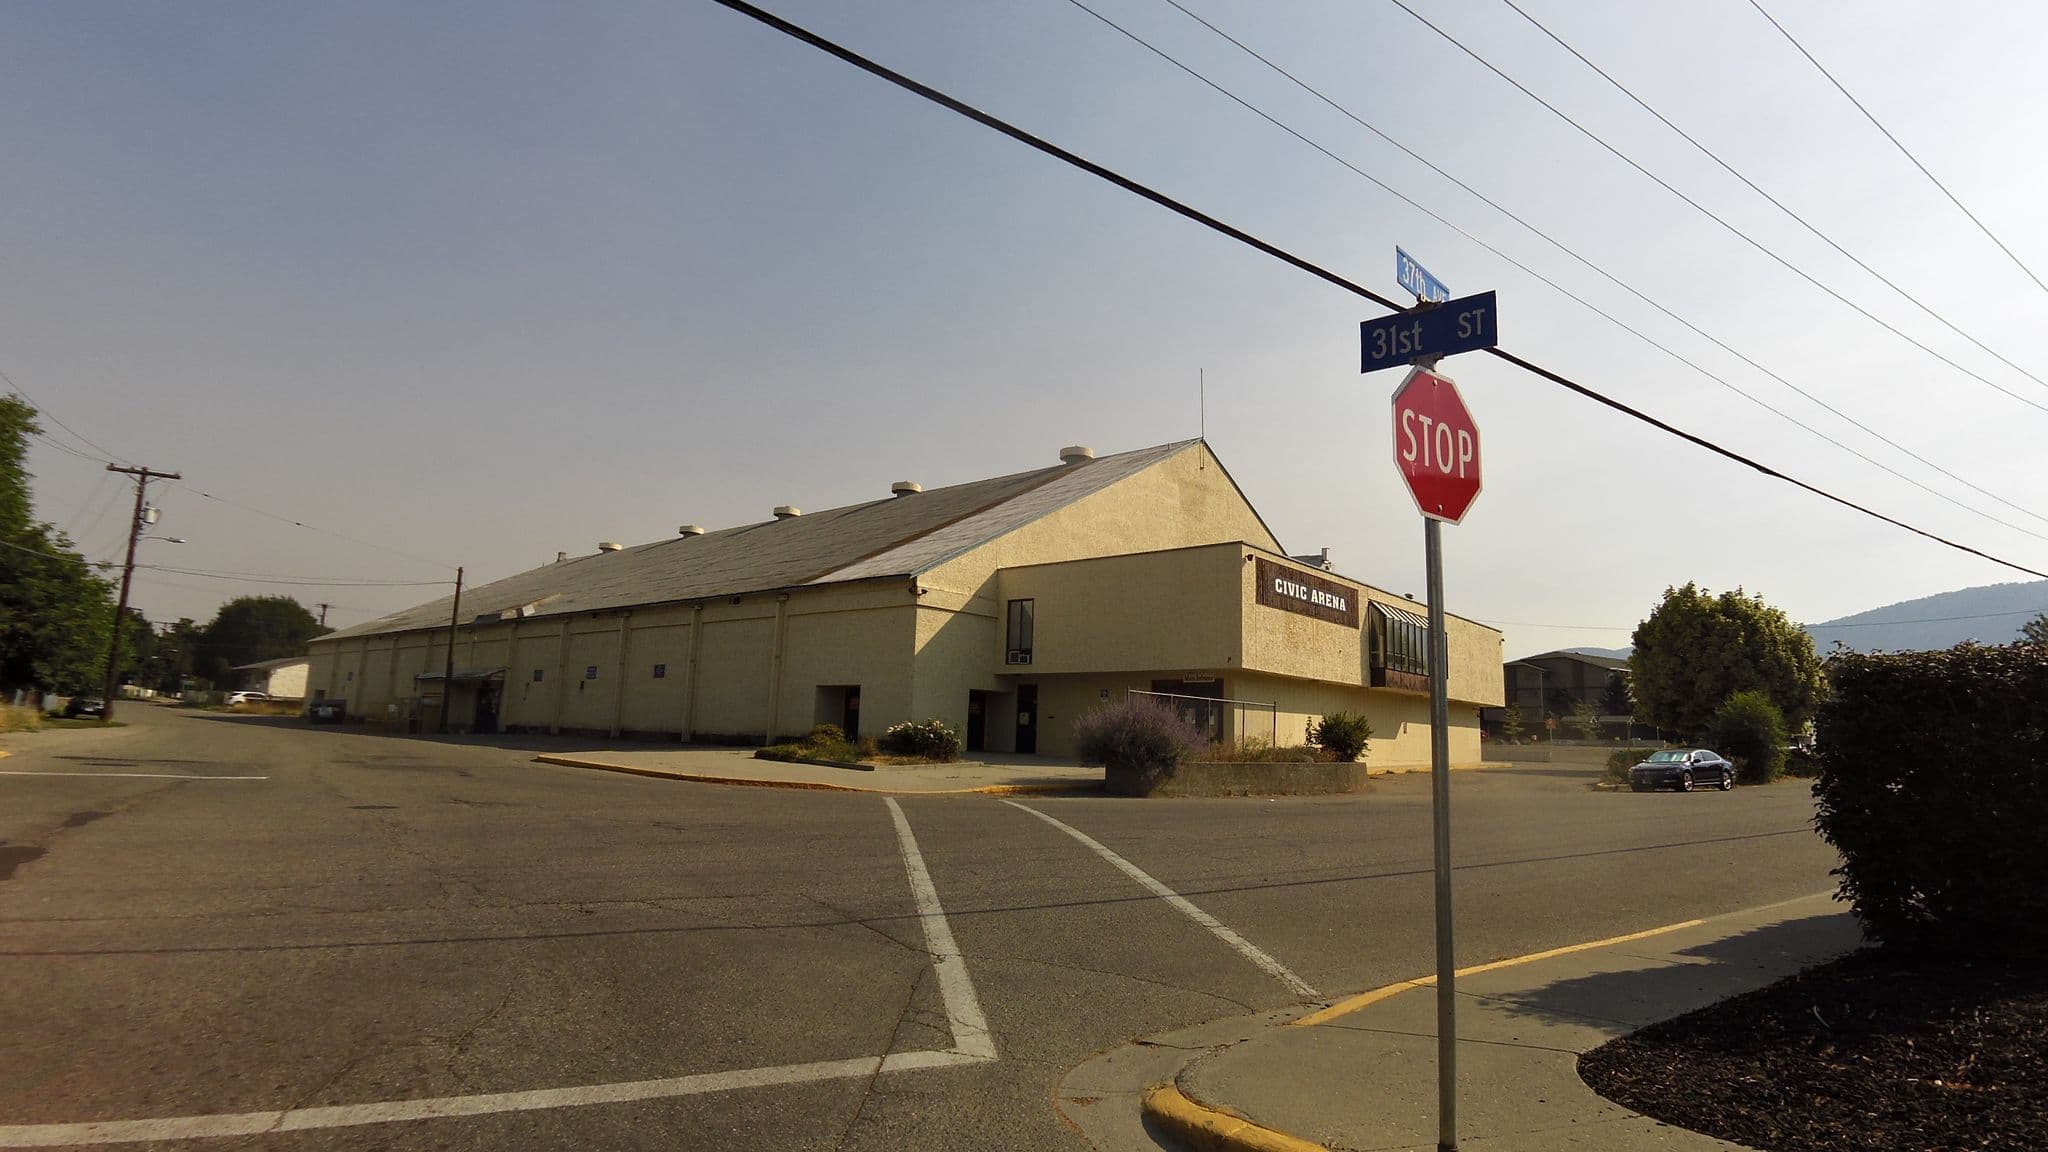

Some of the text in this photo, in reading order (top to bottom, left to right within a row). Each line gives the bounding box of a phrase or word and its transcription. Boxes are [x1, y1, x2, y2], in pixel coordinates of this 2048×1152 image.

[1402, 256, 1426, 302] 37th
[1371, 308, 1485, 359] 31st ST
[1402, 408, 1473, 479] STOP
[1275, 578, 1346, 611] CIVIC ARENA
